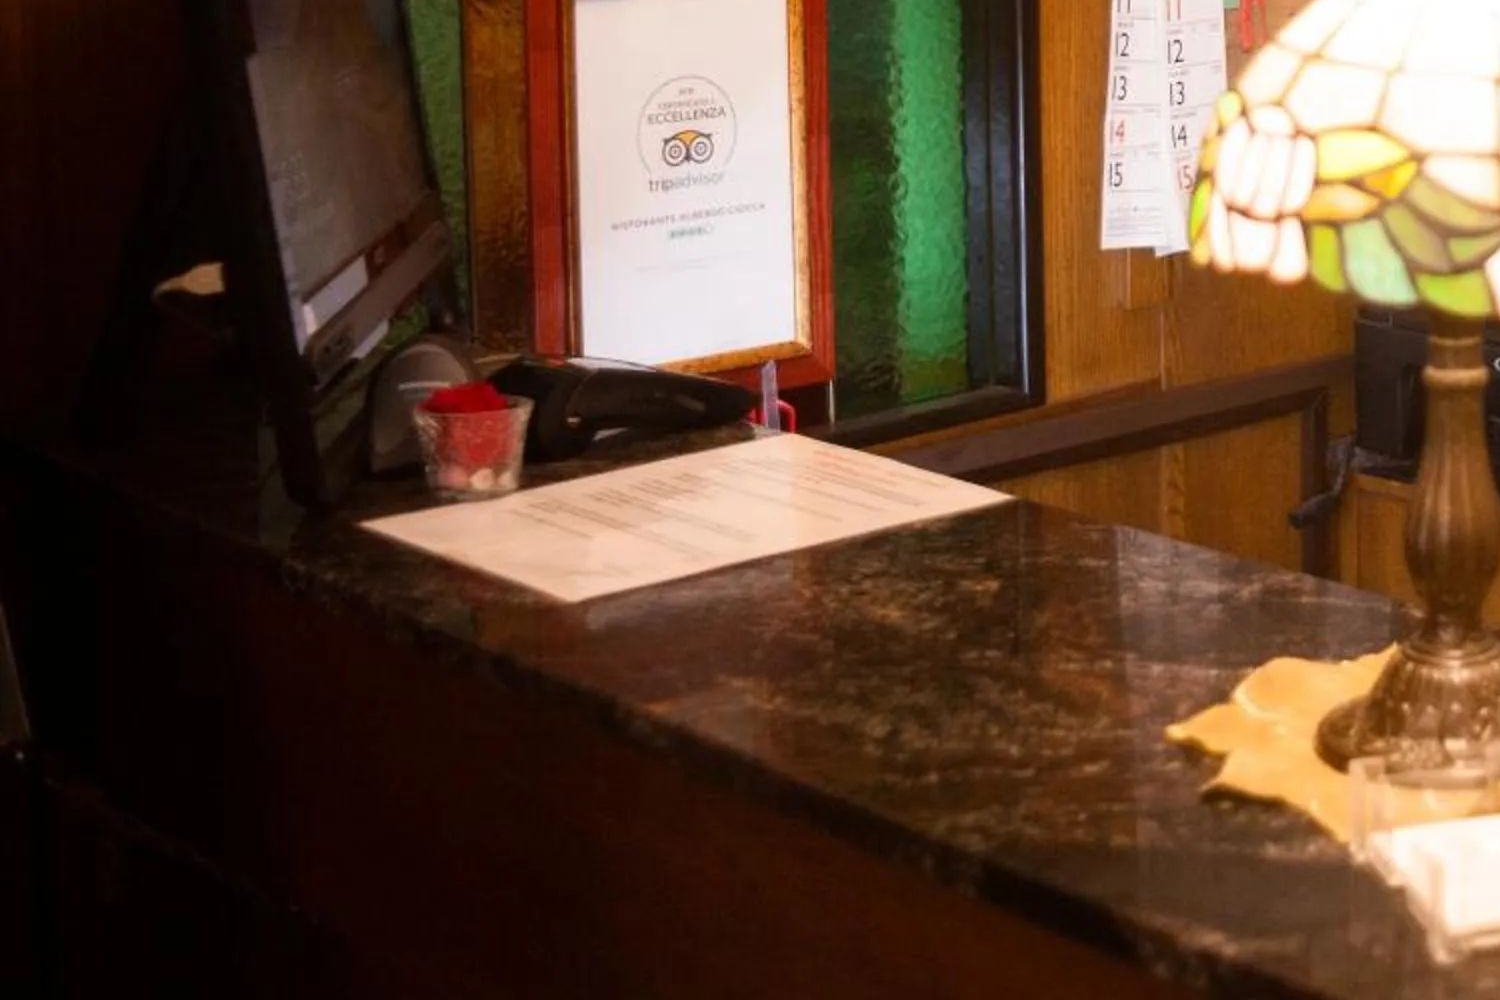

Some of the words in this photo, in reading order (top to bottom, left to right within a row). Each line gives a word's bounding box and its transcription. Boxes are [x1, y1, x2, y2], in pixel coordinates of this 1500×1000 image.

[1115, 32, 1129, 57] 12
[1167, 39, 1183, 64] 12
[1112, 75, 1127, 101] 13
[1169, 81, 1185, 106] 13
[648, 107, 726, 125] ECCELLENZA
[1109, 119, 1125, 143] 14
[1171, 123, 1187, 148] 14
[649, 171, 724, 193] tripadvisor
[1109, 162, 1123, 188] 15
[1177, 165, 1194, 190] 15
